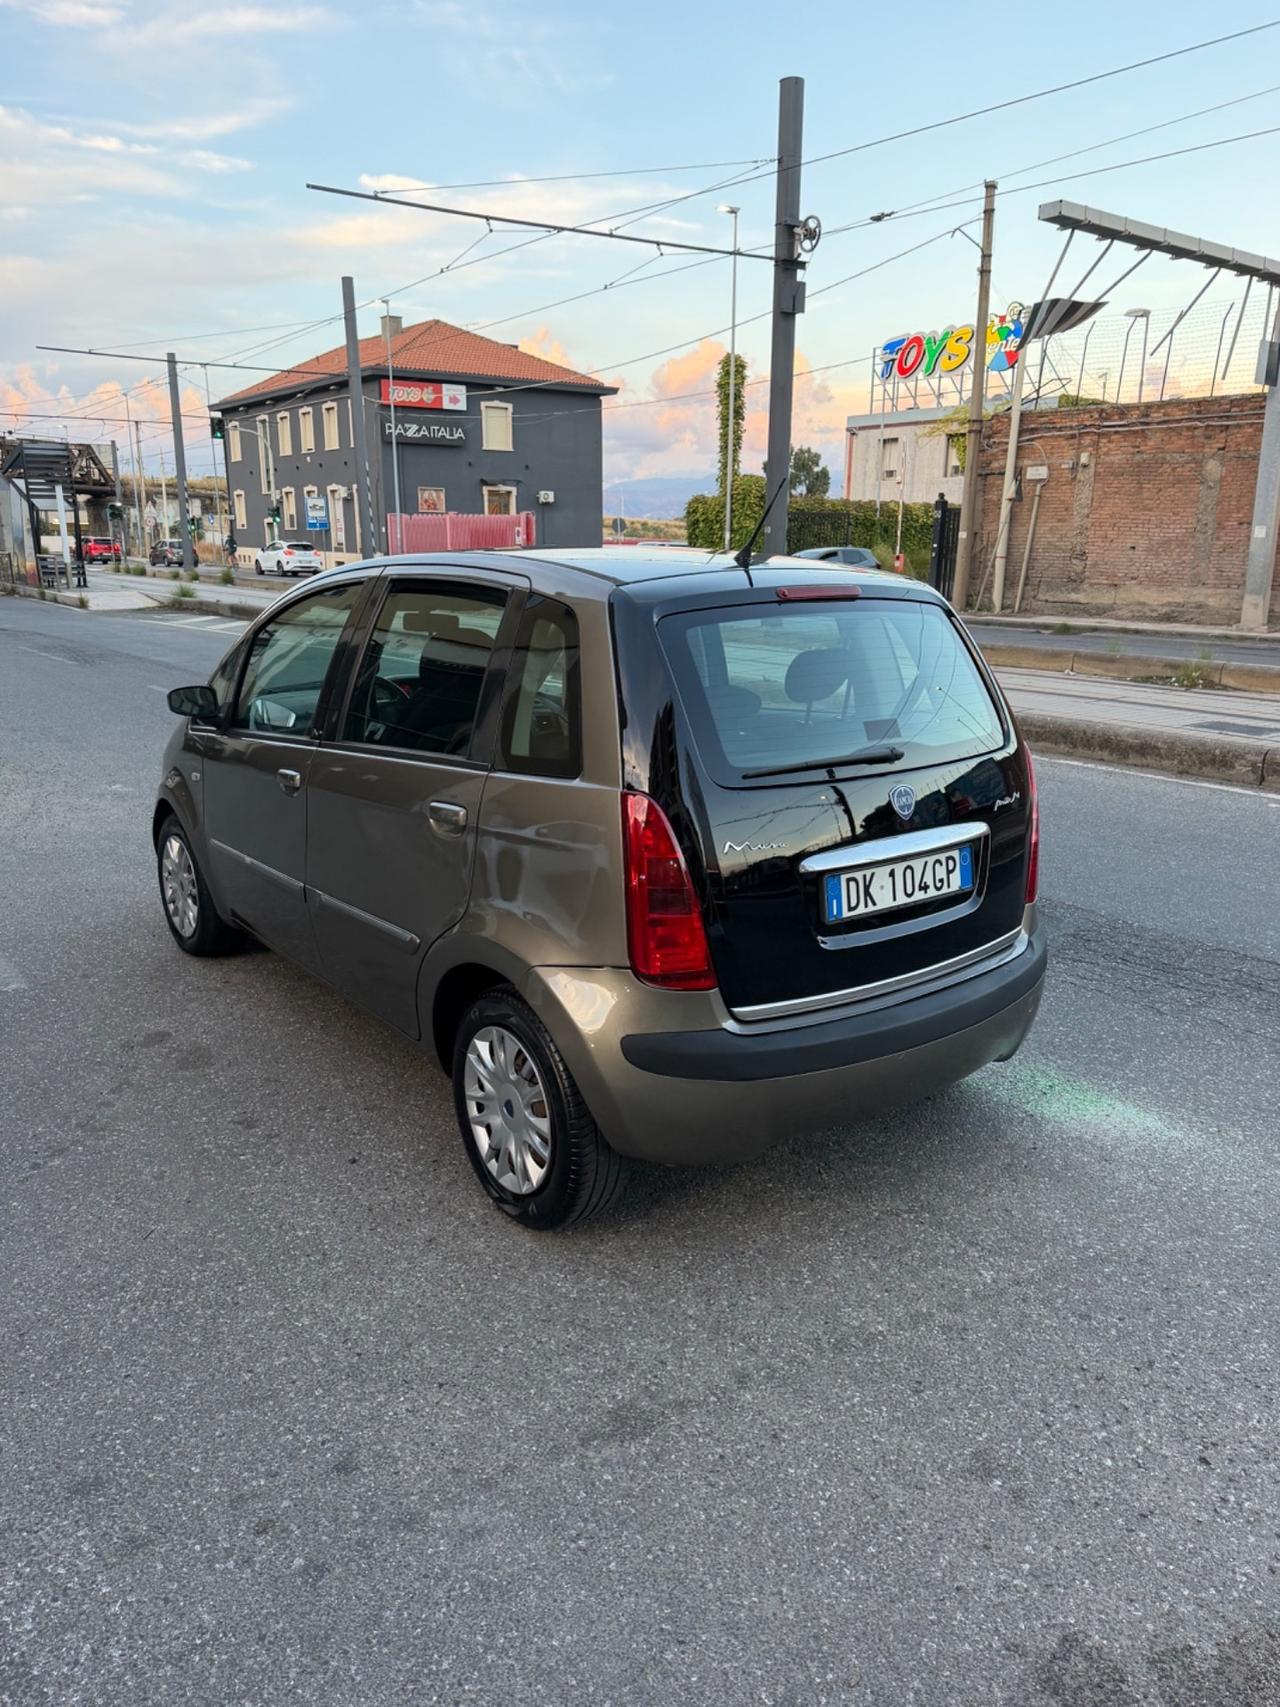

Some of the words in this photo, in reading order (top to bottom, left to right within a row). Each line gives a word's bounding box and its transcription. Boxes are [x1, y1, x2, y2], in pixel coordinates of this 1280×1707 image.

[880, 326, 974, 380] TOYS
[390, 386, 422, 402] TOYS
[385, 423, 429, 438] PAZZA
[430, 426, 466, 440] ITALIA
[845, 871, 877, 912] DK
[888, 855, 957, 902] 104GP
